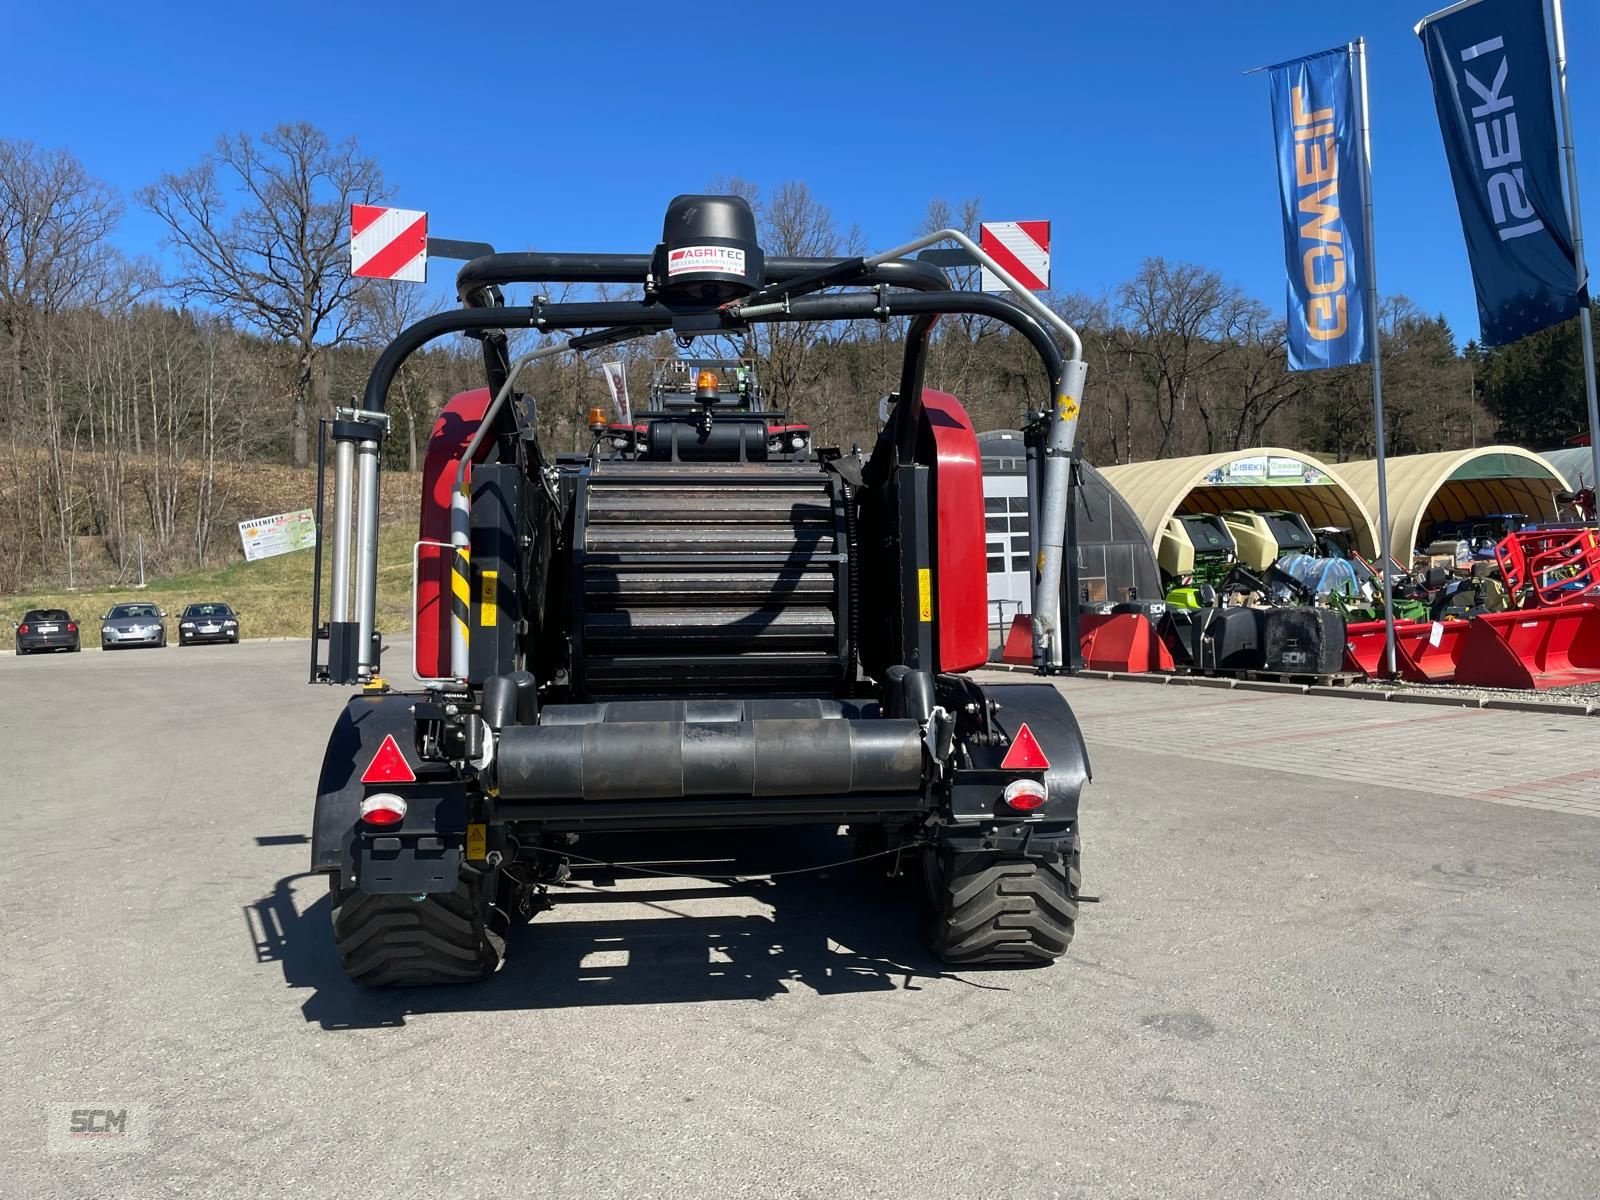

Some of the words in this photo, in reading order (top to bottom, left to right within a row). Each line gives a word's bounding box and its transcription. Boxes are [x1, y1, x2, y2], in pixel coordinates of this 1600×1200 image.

[1461, 35, 1544, 241] ISEKI
[685, 249, 743, 260] AGRITEC
[1239, 463, 1263, 471] ISEKI
[1150, 603, 1166, 614] SCM
[1281, 652, 1306, 664] SCM
